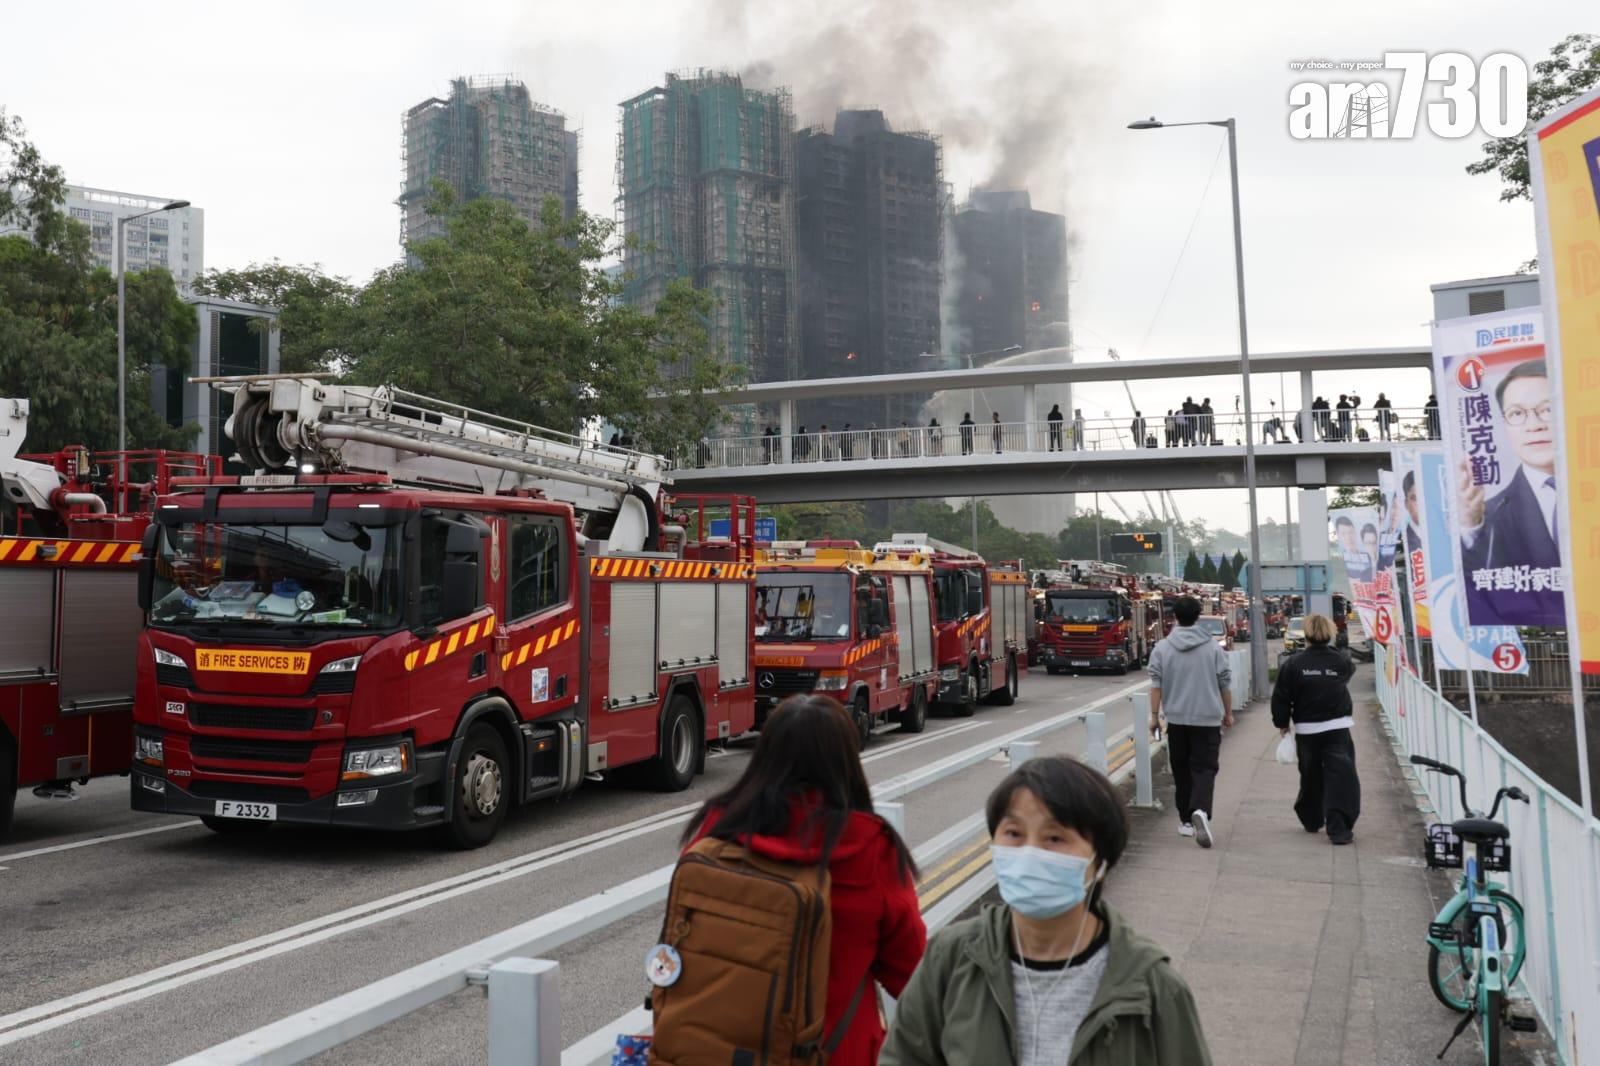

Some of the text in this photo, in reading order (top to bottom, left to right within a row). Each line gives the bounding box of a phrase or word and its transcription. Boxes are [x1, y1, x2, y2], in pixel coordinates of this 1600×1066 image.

[1464, 362, 1479, 388] 1
[1464, 392, 1501, 486] 陳克勤
[200, 653, 307, 671] 消 FIRE SERVICES 防
[1499, 645, 1516, 670] 5
[222, 803, 270, 818] F 2332
